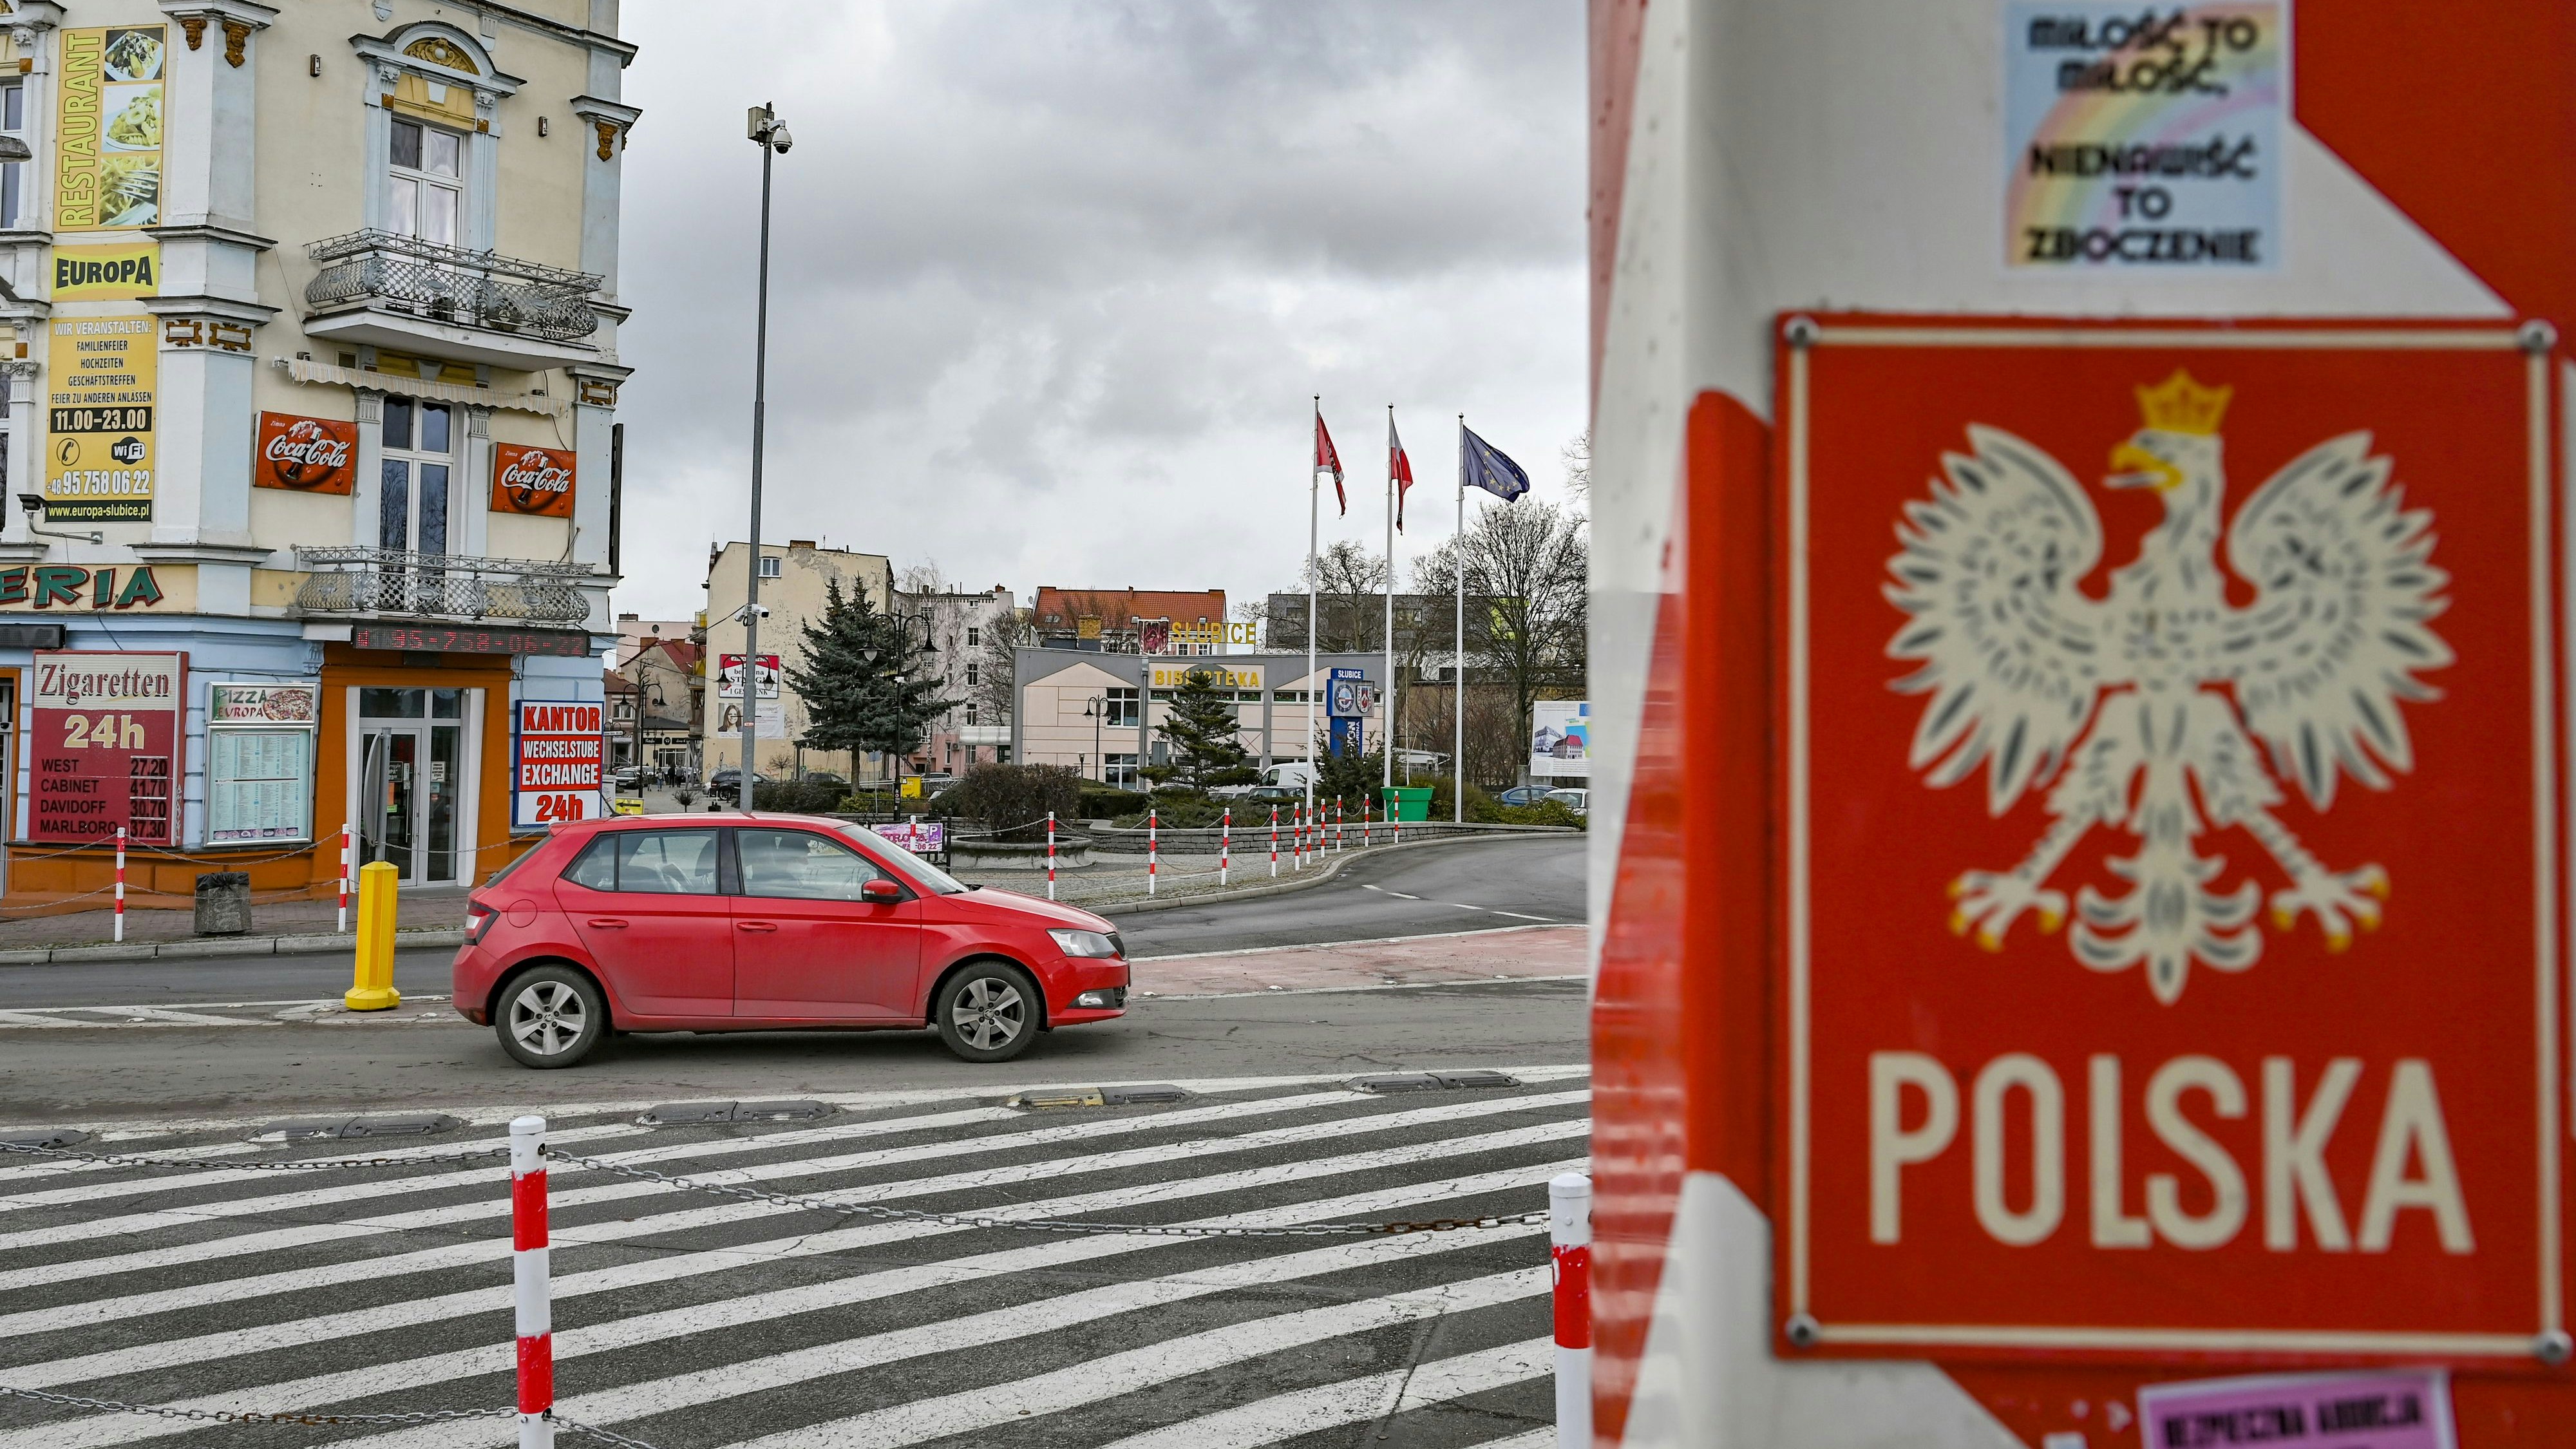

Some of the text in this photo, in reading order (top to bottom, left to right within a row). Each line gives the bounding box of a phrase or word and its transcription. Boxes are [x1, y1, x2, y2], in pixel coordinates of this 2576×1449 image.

[2027, 8, 2259, 52] MIŁOŚĆ TO
[60, 33, 100, 226] RESTAURANT
[2029, 132, 2257, 179] NIENAWIŚĆ
[2112, 185, 2171, 220] TO
[2024, 227, 2261, 264] ZBOCZENIE
[56, 256, 153, 289] EUROPA
[55, 320, 152, 336] WIR VERANSTALTEN:
[77, 340, 128, 352] FAMILIENFEIER
[80, 357, 124, 369] HOCHZEITEN
[68, 373, 135, 386] GESCHÄFTSTREFFEN
[52, 390, 152, 404] FEIER ZU ANDEREN ANLÄSSEN
[265, 435, 351, 468] Coca-Cola
[46, 469, 150, 495] +48 95 758 06 22
[500, 463, 572, 493] Coca-Cola
[48, 504, 149, 519] www.europa-slubice.pl
[1171, 621, 1256, 644] SŁUBICE
[39, 663, 169, 705] Zigaretten
[1338, 670, 1361, 679] SŁUBICE
[216, 689, 267, 703] PIZZA
[524, 706, 600, 732] KANTOR
[63, 714, 145, 750] 24h
[523, 740, 599, 758] WECHSELSTUBE
[42, 759, 168, 776] WEST 27.20
[522, 763, 599, 786] EXCHANGE
[41, 779, 166, 797] CABINET 41.70
[40, 800, 166, 817] DAVIDOFF 30.70
[535, 794, 583, 822] 24h
[40, 819, 166, 838] MARLBORO 37.30
[930, 826, 938, 835] P
[1868, 1050, 2477, 1253] POLSKA
